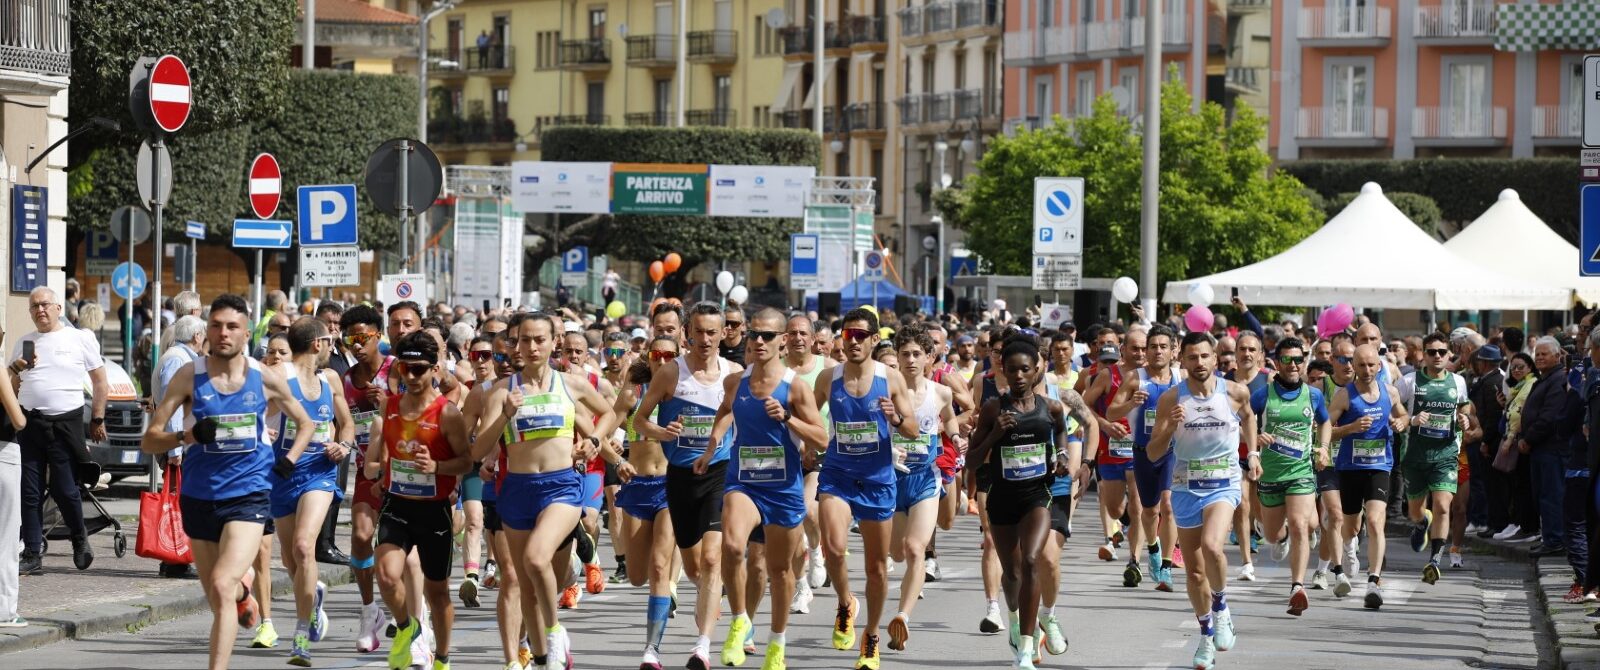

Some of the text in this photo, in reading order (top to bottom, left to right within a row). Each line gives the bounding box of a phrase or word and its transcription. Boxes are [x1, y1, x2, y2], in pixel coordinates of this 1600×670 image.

[626, 176, 693, 190] PARTENZA
[635, 190, 684, 204] ARRIVO
[309, 191, 347, 240] P
[1042, 229, 1051, 240] P
[566, 249, 583, 270] P
[534, 405, 545, 413] 13
[227, 428, 234, 437] 5
[694, 427, 707, 435] 10
[849, 433, 862, 441] 20
[757, 458, 764, 466] 7
[408, 473, 414, 481] 6
[1203, 470, 1214, 478] 27
